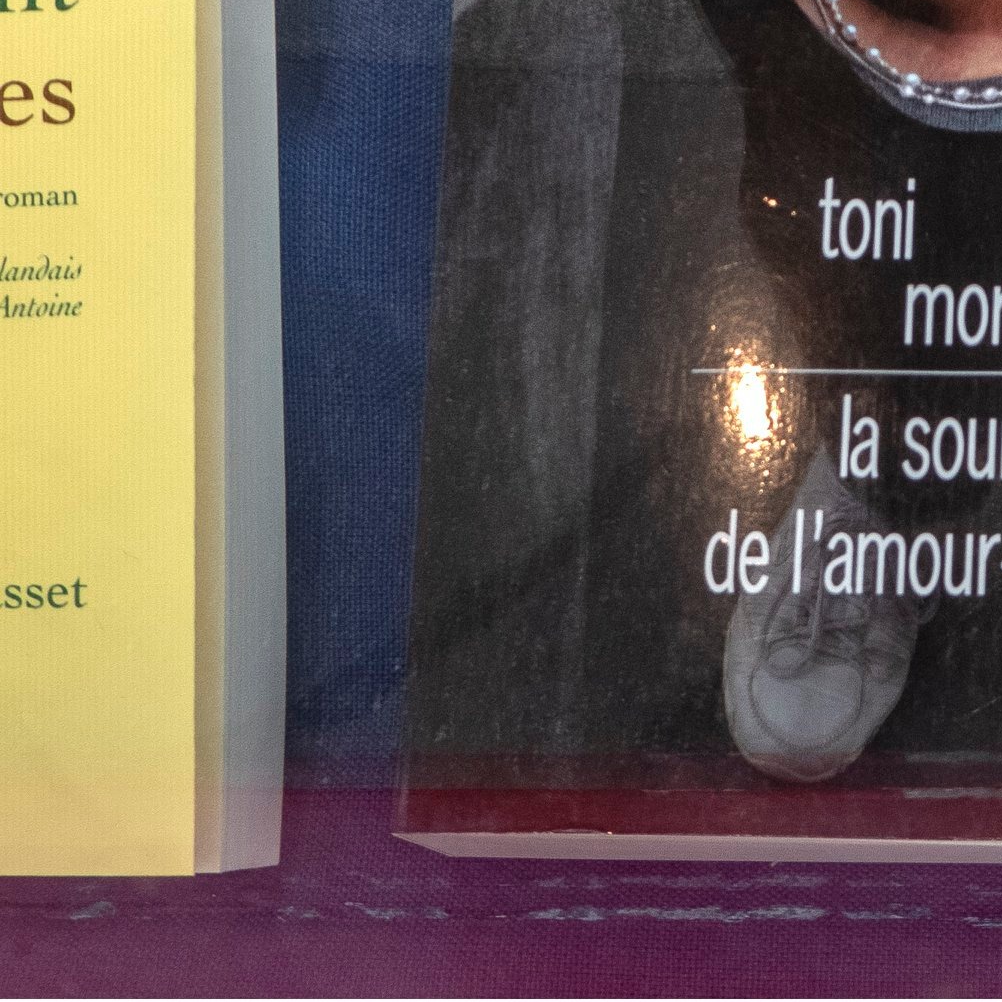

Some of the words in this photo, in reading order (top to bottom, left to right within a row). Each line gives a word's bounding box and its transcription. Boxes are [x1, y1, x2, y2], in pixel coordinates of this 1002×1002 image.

[0, 188, 78, 208] oman
[818, 177, 916, 260] toni
[839, 393, 880, 479] la
[0, 576, 88, 609] sset
[703, 508, 770, 595] de
